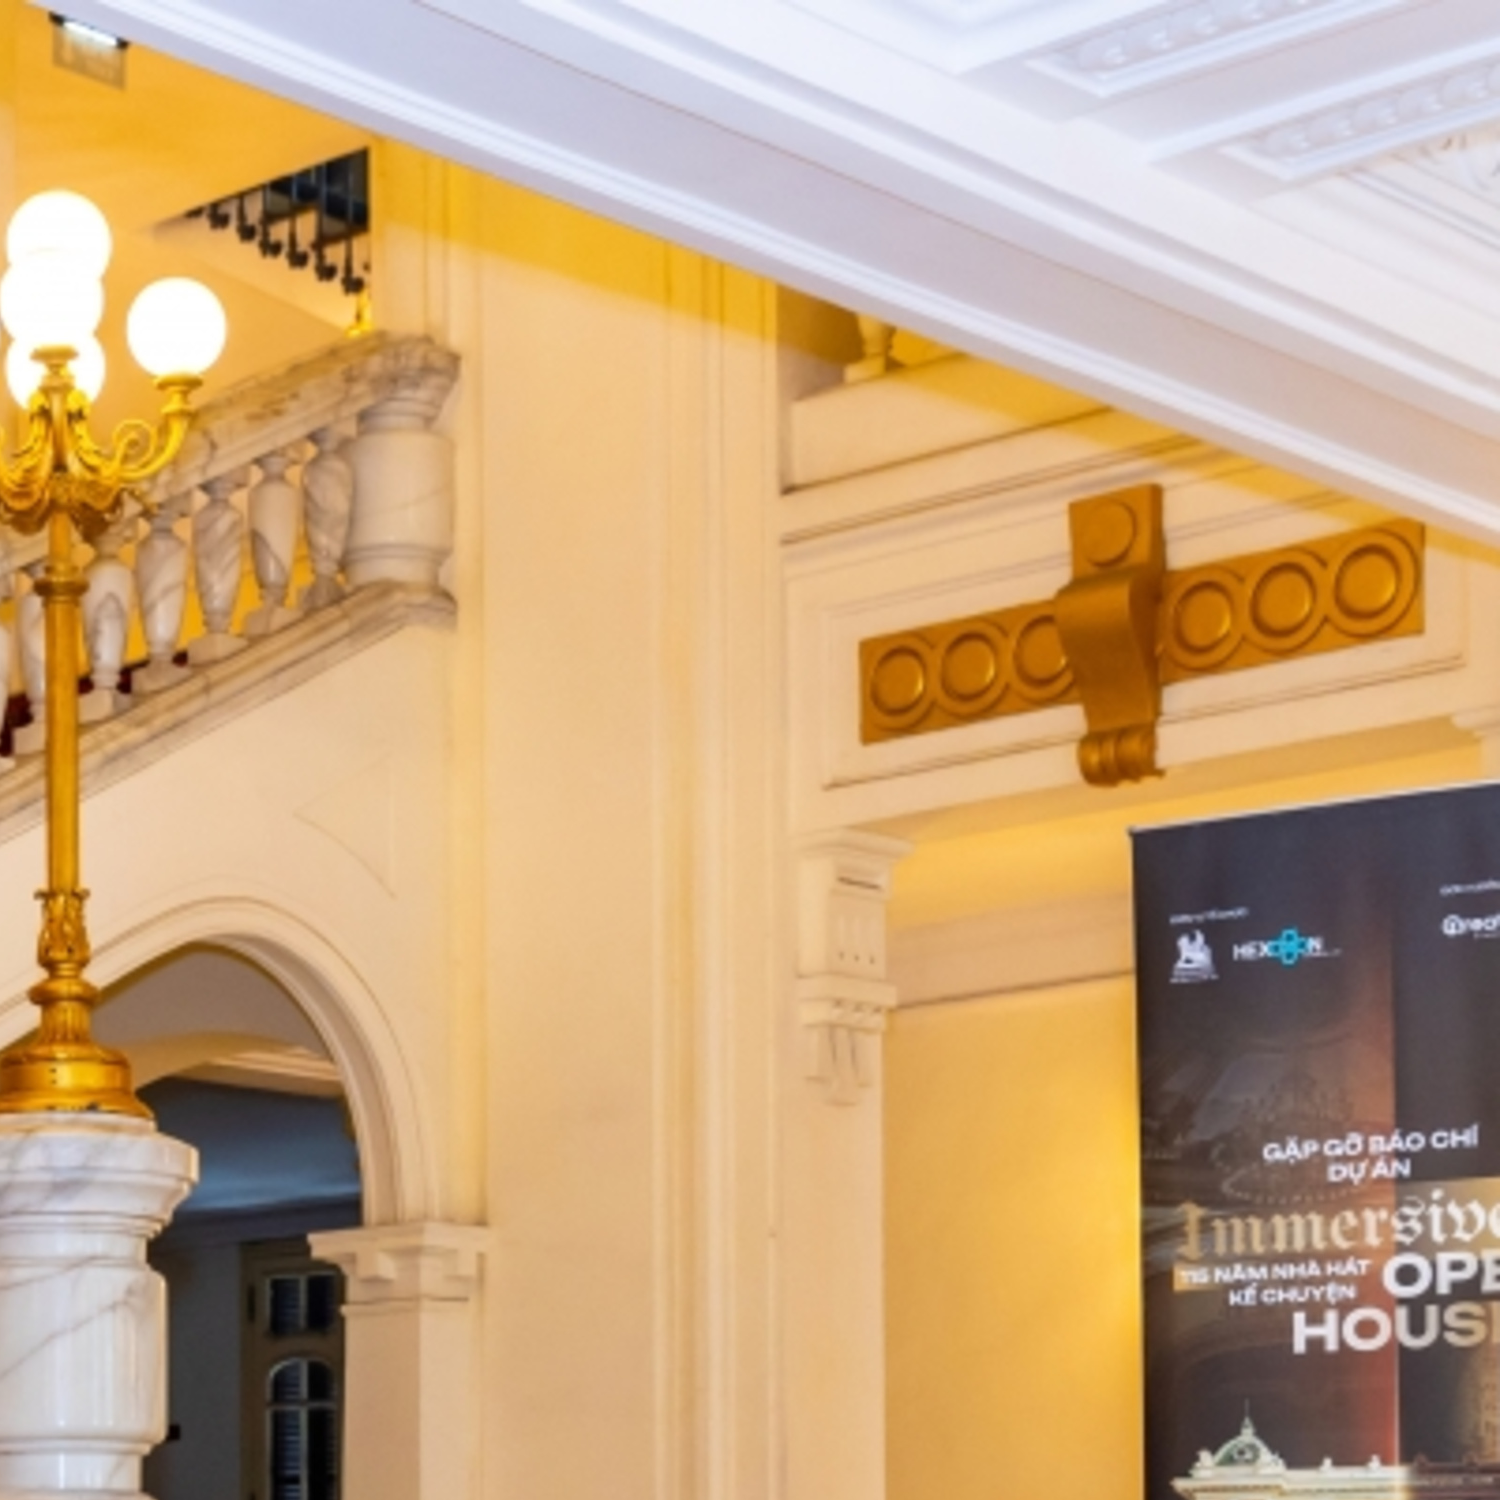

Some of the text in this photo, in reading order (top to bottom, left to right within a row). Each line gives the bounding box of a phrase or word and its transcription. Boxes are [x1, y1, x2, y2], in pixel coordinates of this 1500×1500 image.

[1262, 1121, 1480, 1165] GẶP GỠ BÁO CHÍ
[1327, 1155, 1412, 1186] DỰ ÁN
[1214, 1261, 1269, 1284] NĂM
[1271, 1258, 1322, 1280] NHÀ
[1326, 1255, 1372, 1277] HÁT
[1292, 1300, 1500, 1355] HOUS
